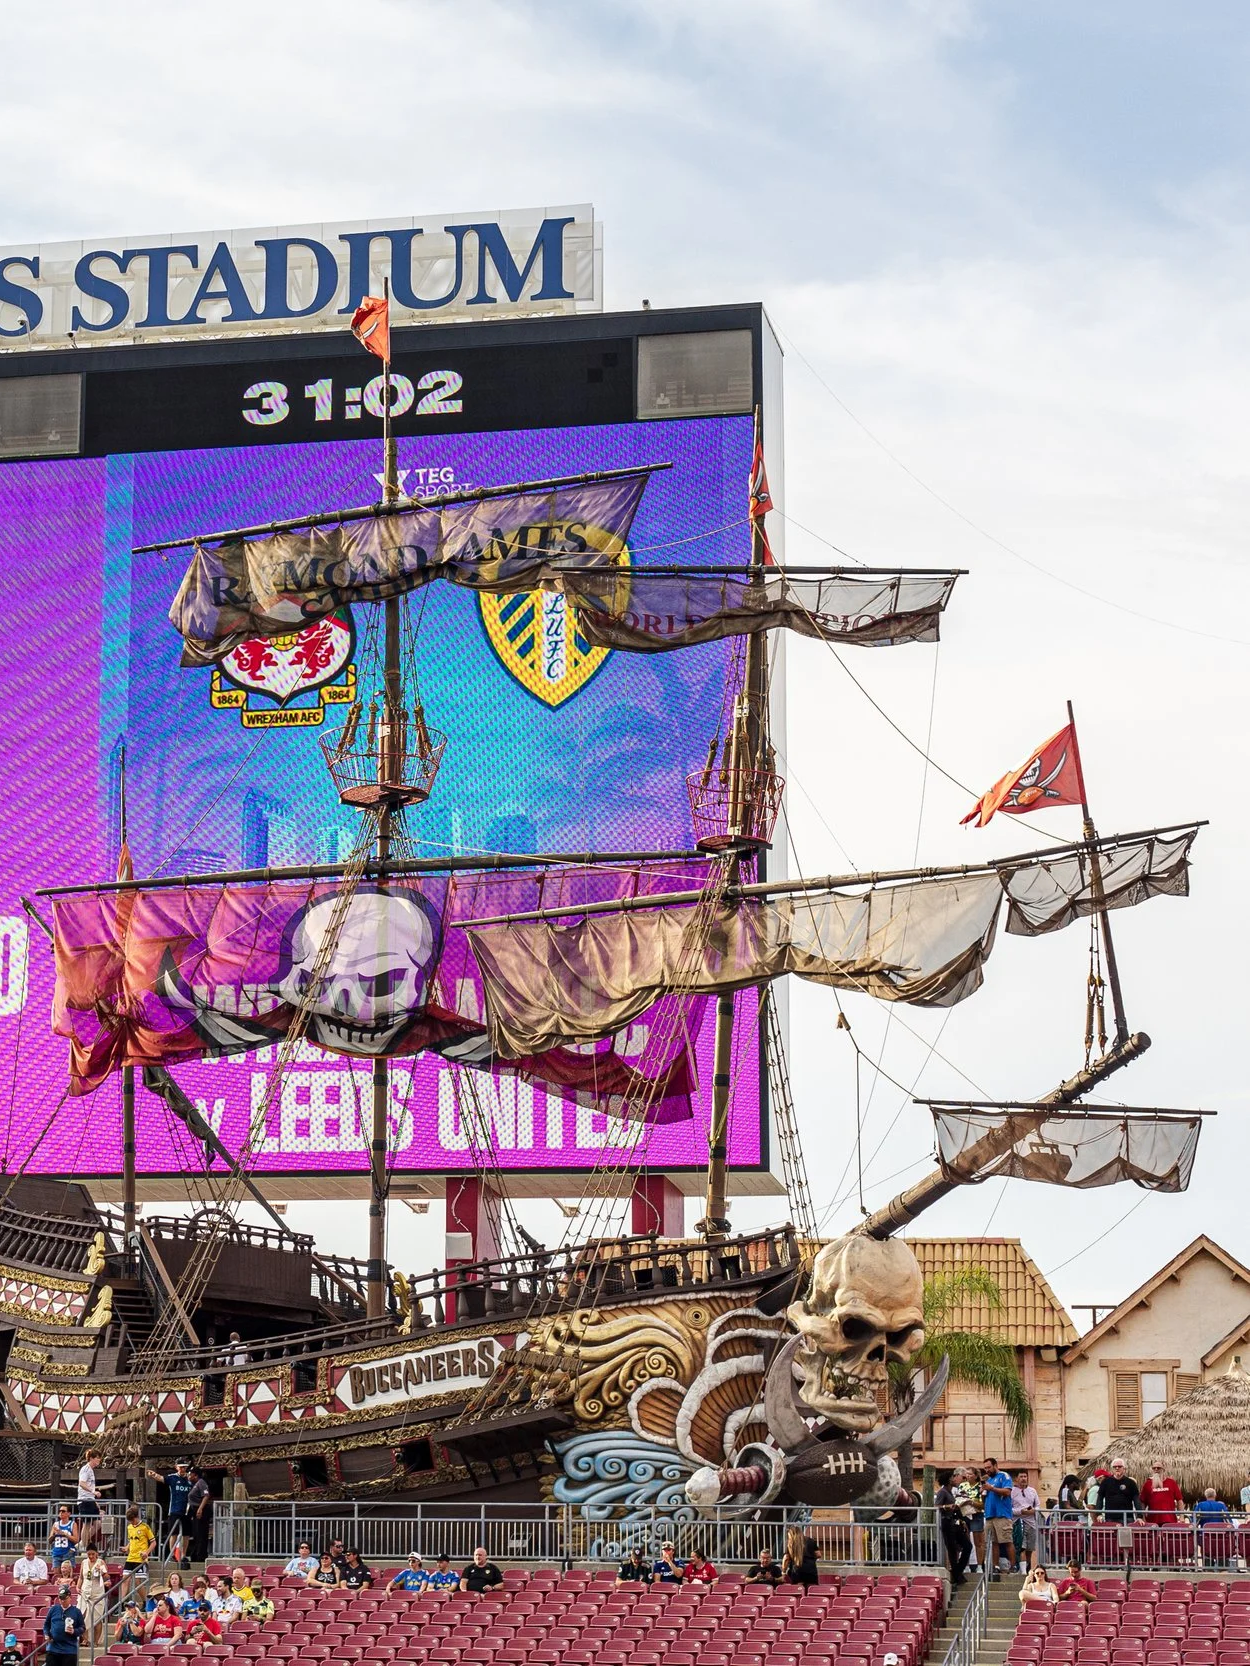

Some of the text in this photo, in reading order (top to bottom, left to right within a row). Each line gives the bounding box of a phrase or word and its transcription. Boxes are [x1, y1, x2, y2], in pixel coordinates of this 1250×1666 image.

[71, 217, 576, 332] STADIUM
[242, 370, 463, 425] 31:02
[415, 466, 455, 484] TEG
[441, 522, 588, 562] AMES
[217, 694, 239, 705] 1864
[328, 690, 350, 700] 1864
[246, 712, 320, 725] WREXHAM AFC
[250, 1069, 414, 1152] LEEDS
[350, 1340, 495, 1404] BUCCANEERS
